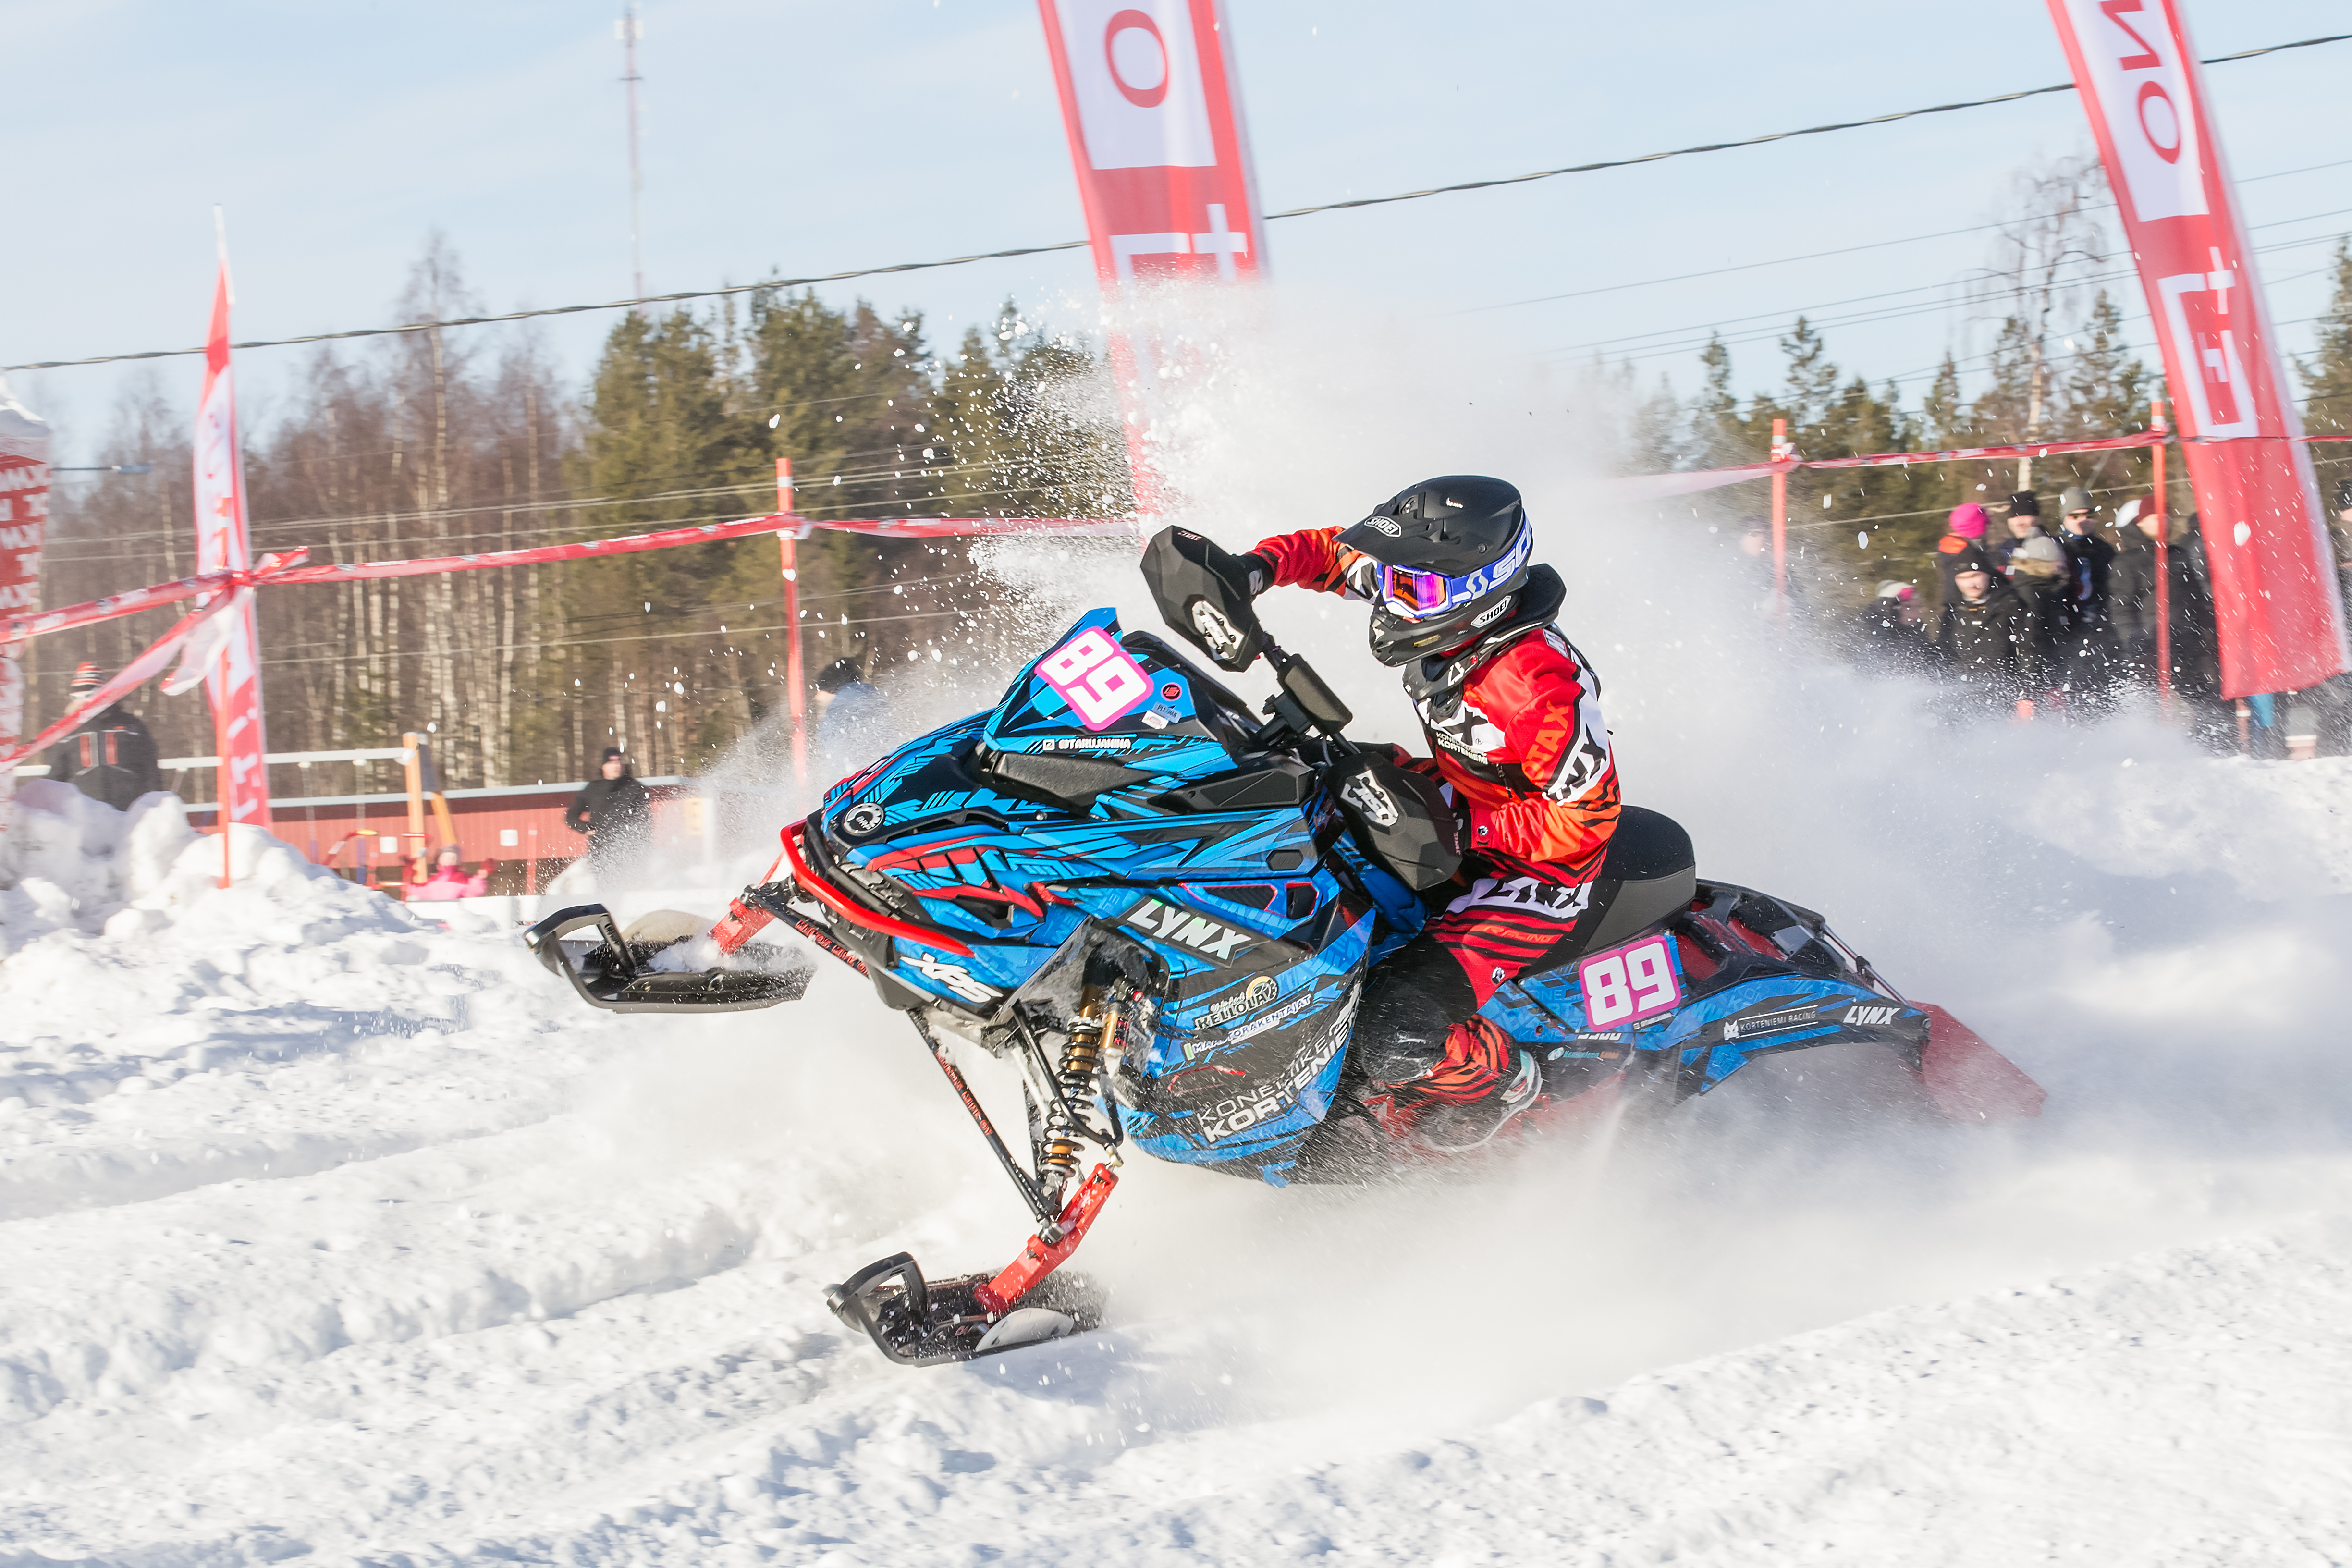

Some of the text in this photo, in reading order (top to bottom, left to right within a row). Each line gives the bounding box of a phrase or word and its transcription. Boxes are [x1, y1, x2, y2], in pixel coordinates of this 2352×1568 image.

[1367, 518, 1399, 534] SHOEI
[1479, 600, 1507, 624] SHOEI
[1041, 630, 1148, 724] 89
[1127, 898, 1252, 960] LYNX
[1584, 942, 1677, 1026] 89
[1196, 993, 1269, 1030] KELLOLA
[1740, 1011, 1816, 1031] KORTENIEMI RACING
[1843, 1006, 1901, 1026] LYNX
